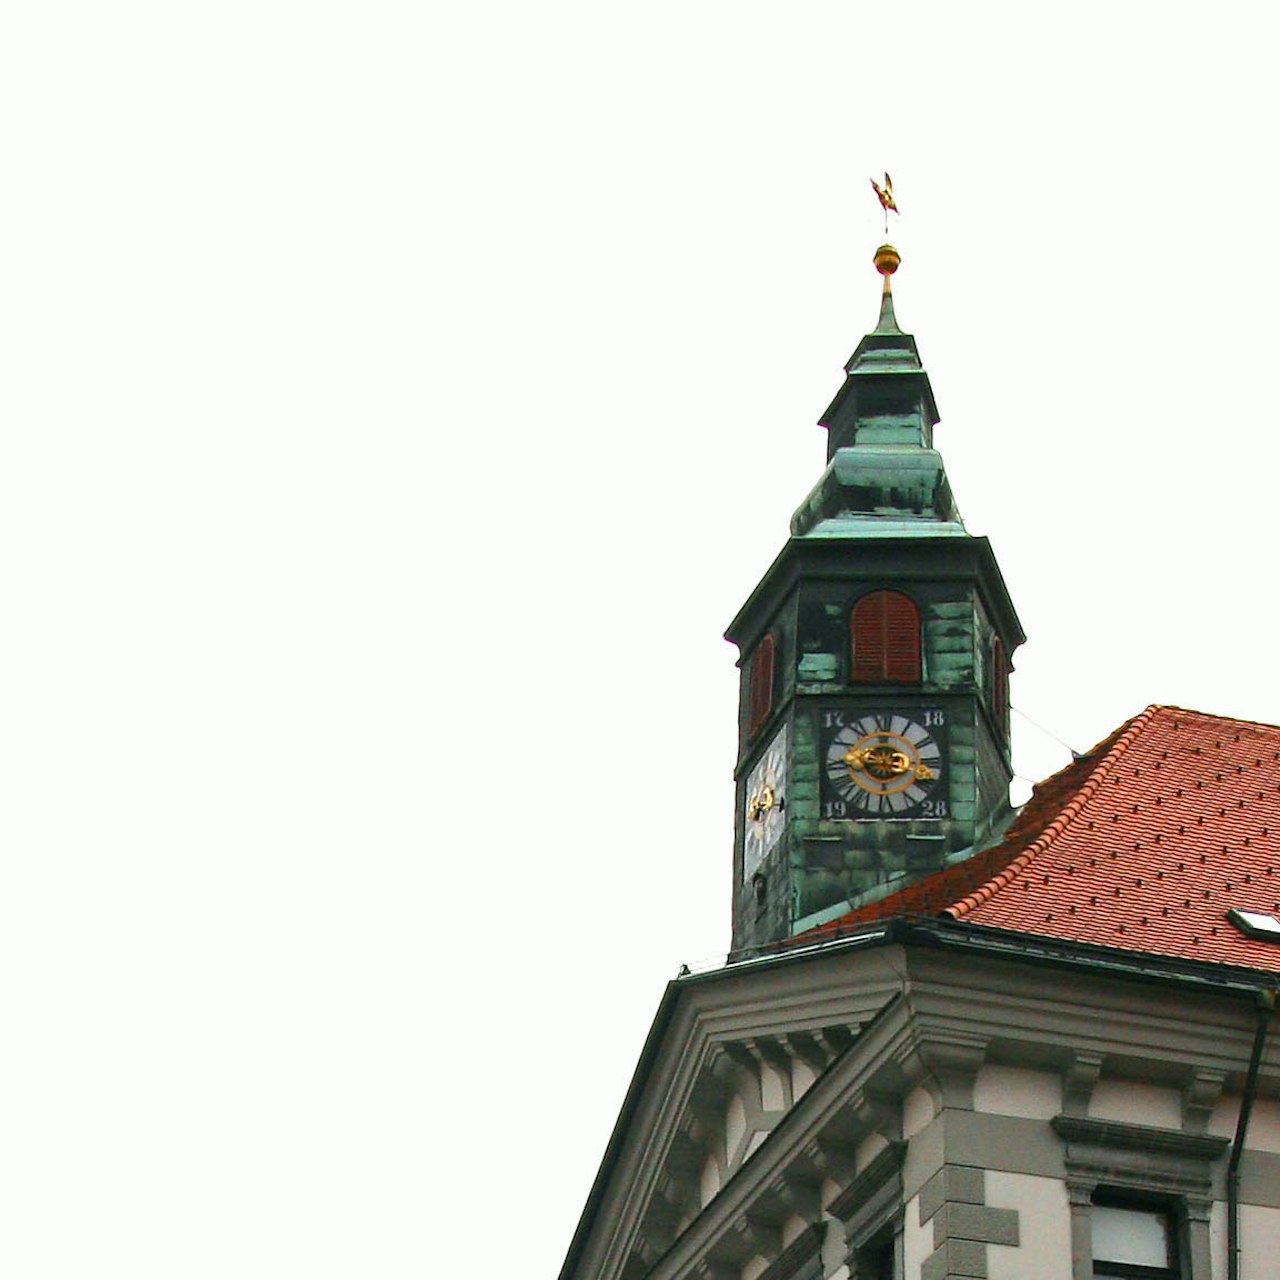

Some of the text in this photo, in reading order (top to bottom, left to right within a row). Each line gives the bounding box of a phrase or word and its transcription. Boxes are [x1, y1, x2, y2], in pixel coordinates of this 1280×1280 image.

[825, 710, 945, 728] 17 18
[825, 800, 947, 817] 19 28
